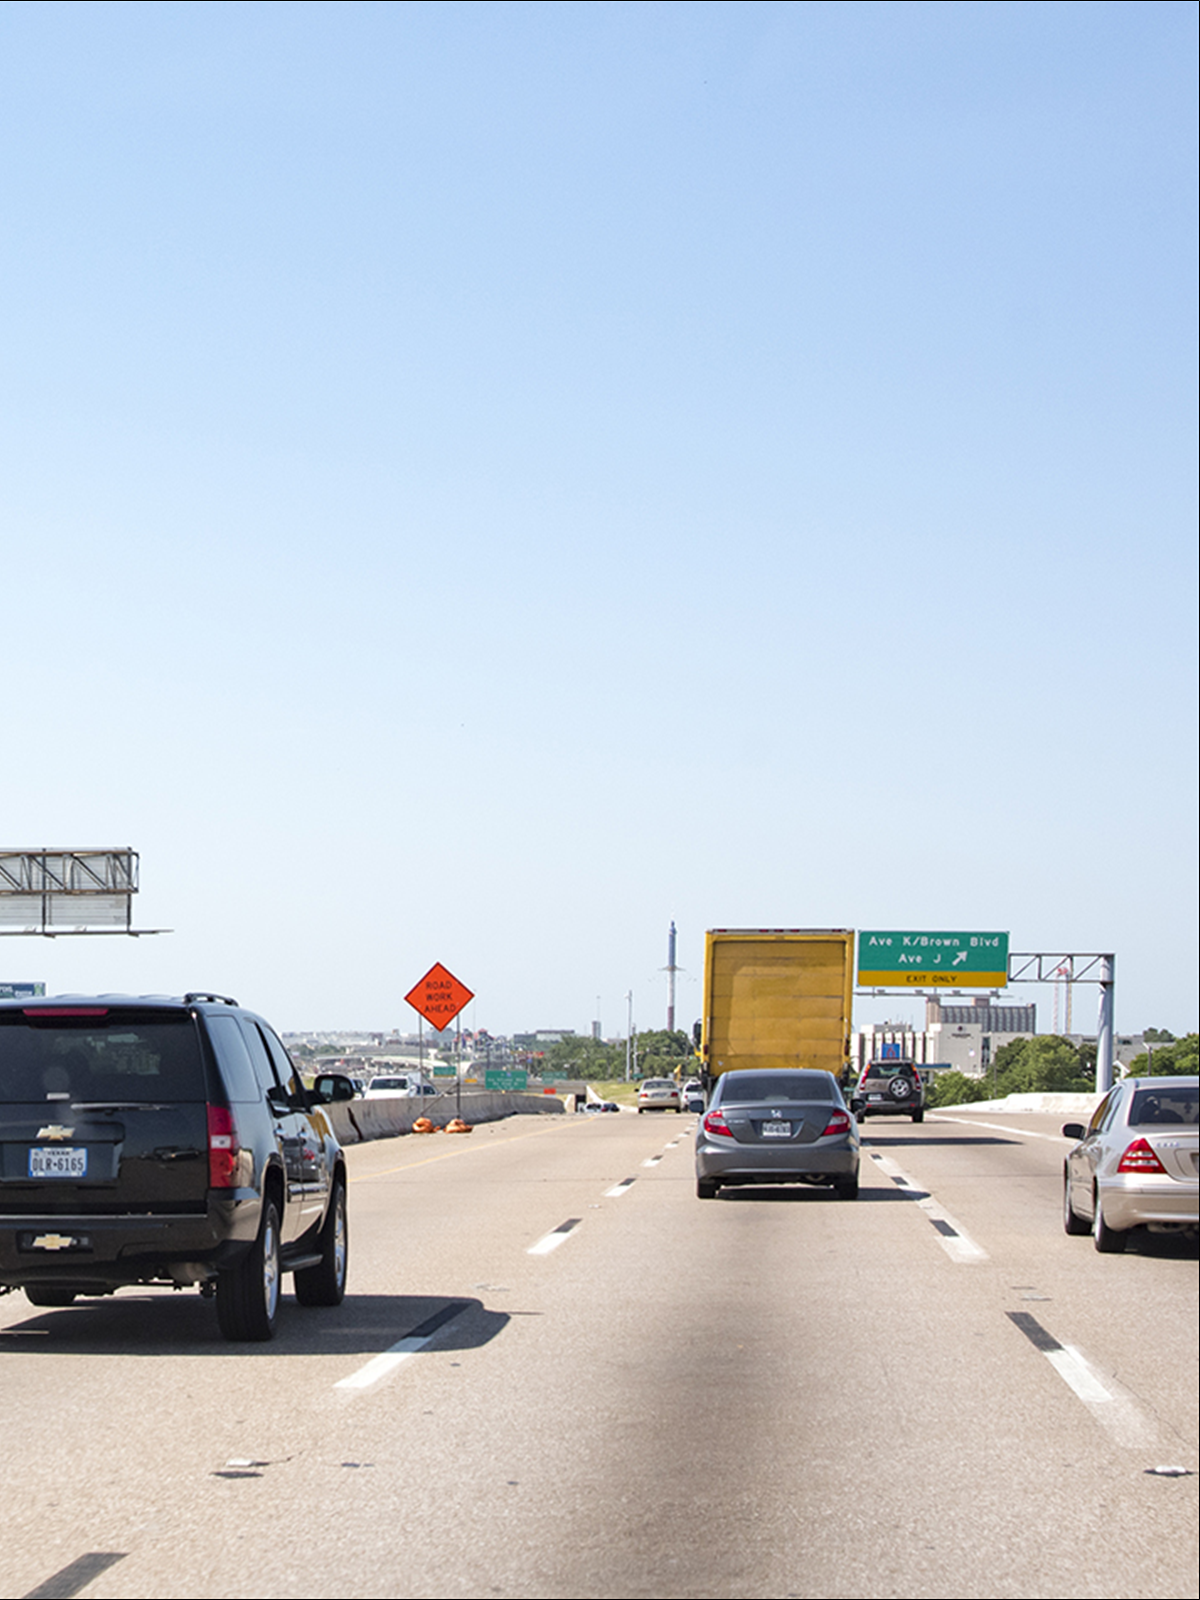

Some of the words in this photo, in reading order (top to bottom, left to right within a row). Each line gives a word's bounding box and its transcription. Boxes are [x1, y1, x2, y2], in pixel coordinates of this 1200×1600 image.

[868, 936, 893, 946] Ave
[902, 936, 960, 947] K/Brown
[969, 937, 999, 947] Blvd
[898, 953, 922, 964] Ave
[932, 953, 942, 964] J
[906, 975, 927, 983] EXIT
[931, 975, 958, 983] ONLY
[425, 981, 453, 990] ROAD
[426, 993, 453, 1002] WORK
[424, 1004, 457, 1013] AHEAD
